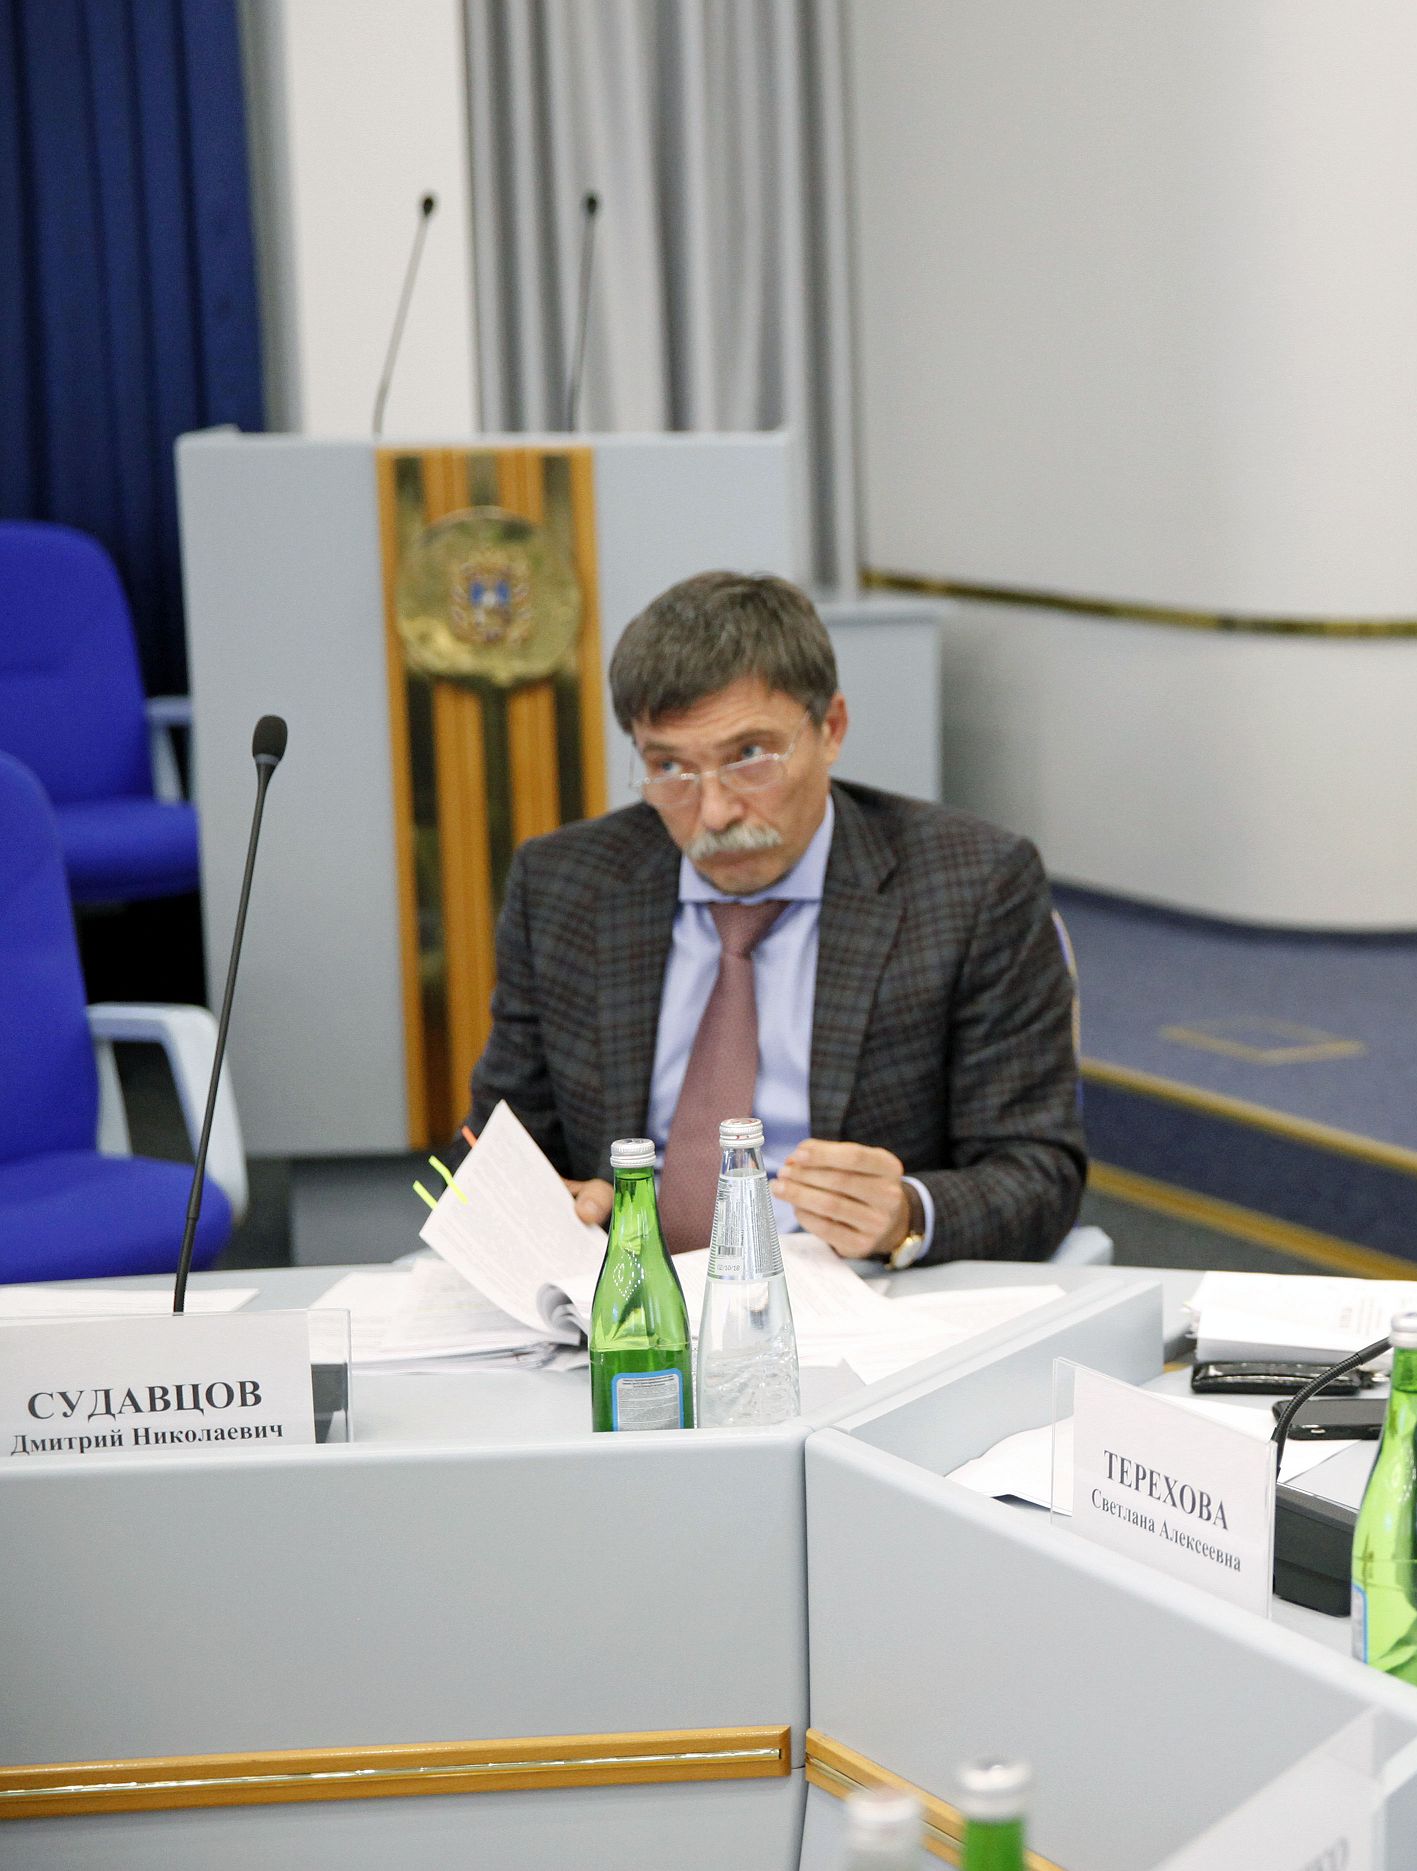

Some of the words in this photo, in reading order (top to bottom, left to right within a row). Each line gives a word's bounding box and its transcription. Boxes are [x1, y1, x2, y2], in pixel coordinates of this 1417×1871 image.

[27, 1381, 262, 1422] СУДАВЦОВ
[10, 1429, 124, 1456] Дмитрий
[133, 1423, 284, 1446] Николаевич
[1104, 1450, 1229, 1530] ТЕРЕХОВА
[1091, 1488, 1155, 1533] Светлана
[1159, 1520, 1241, 1571] Алексеевна
